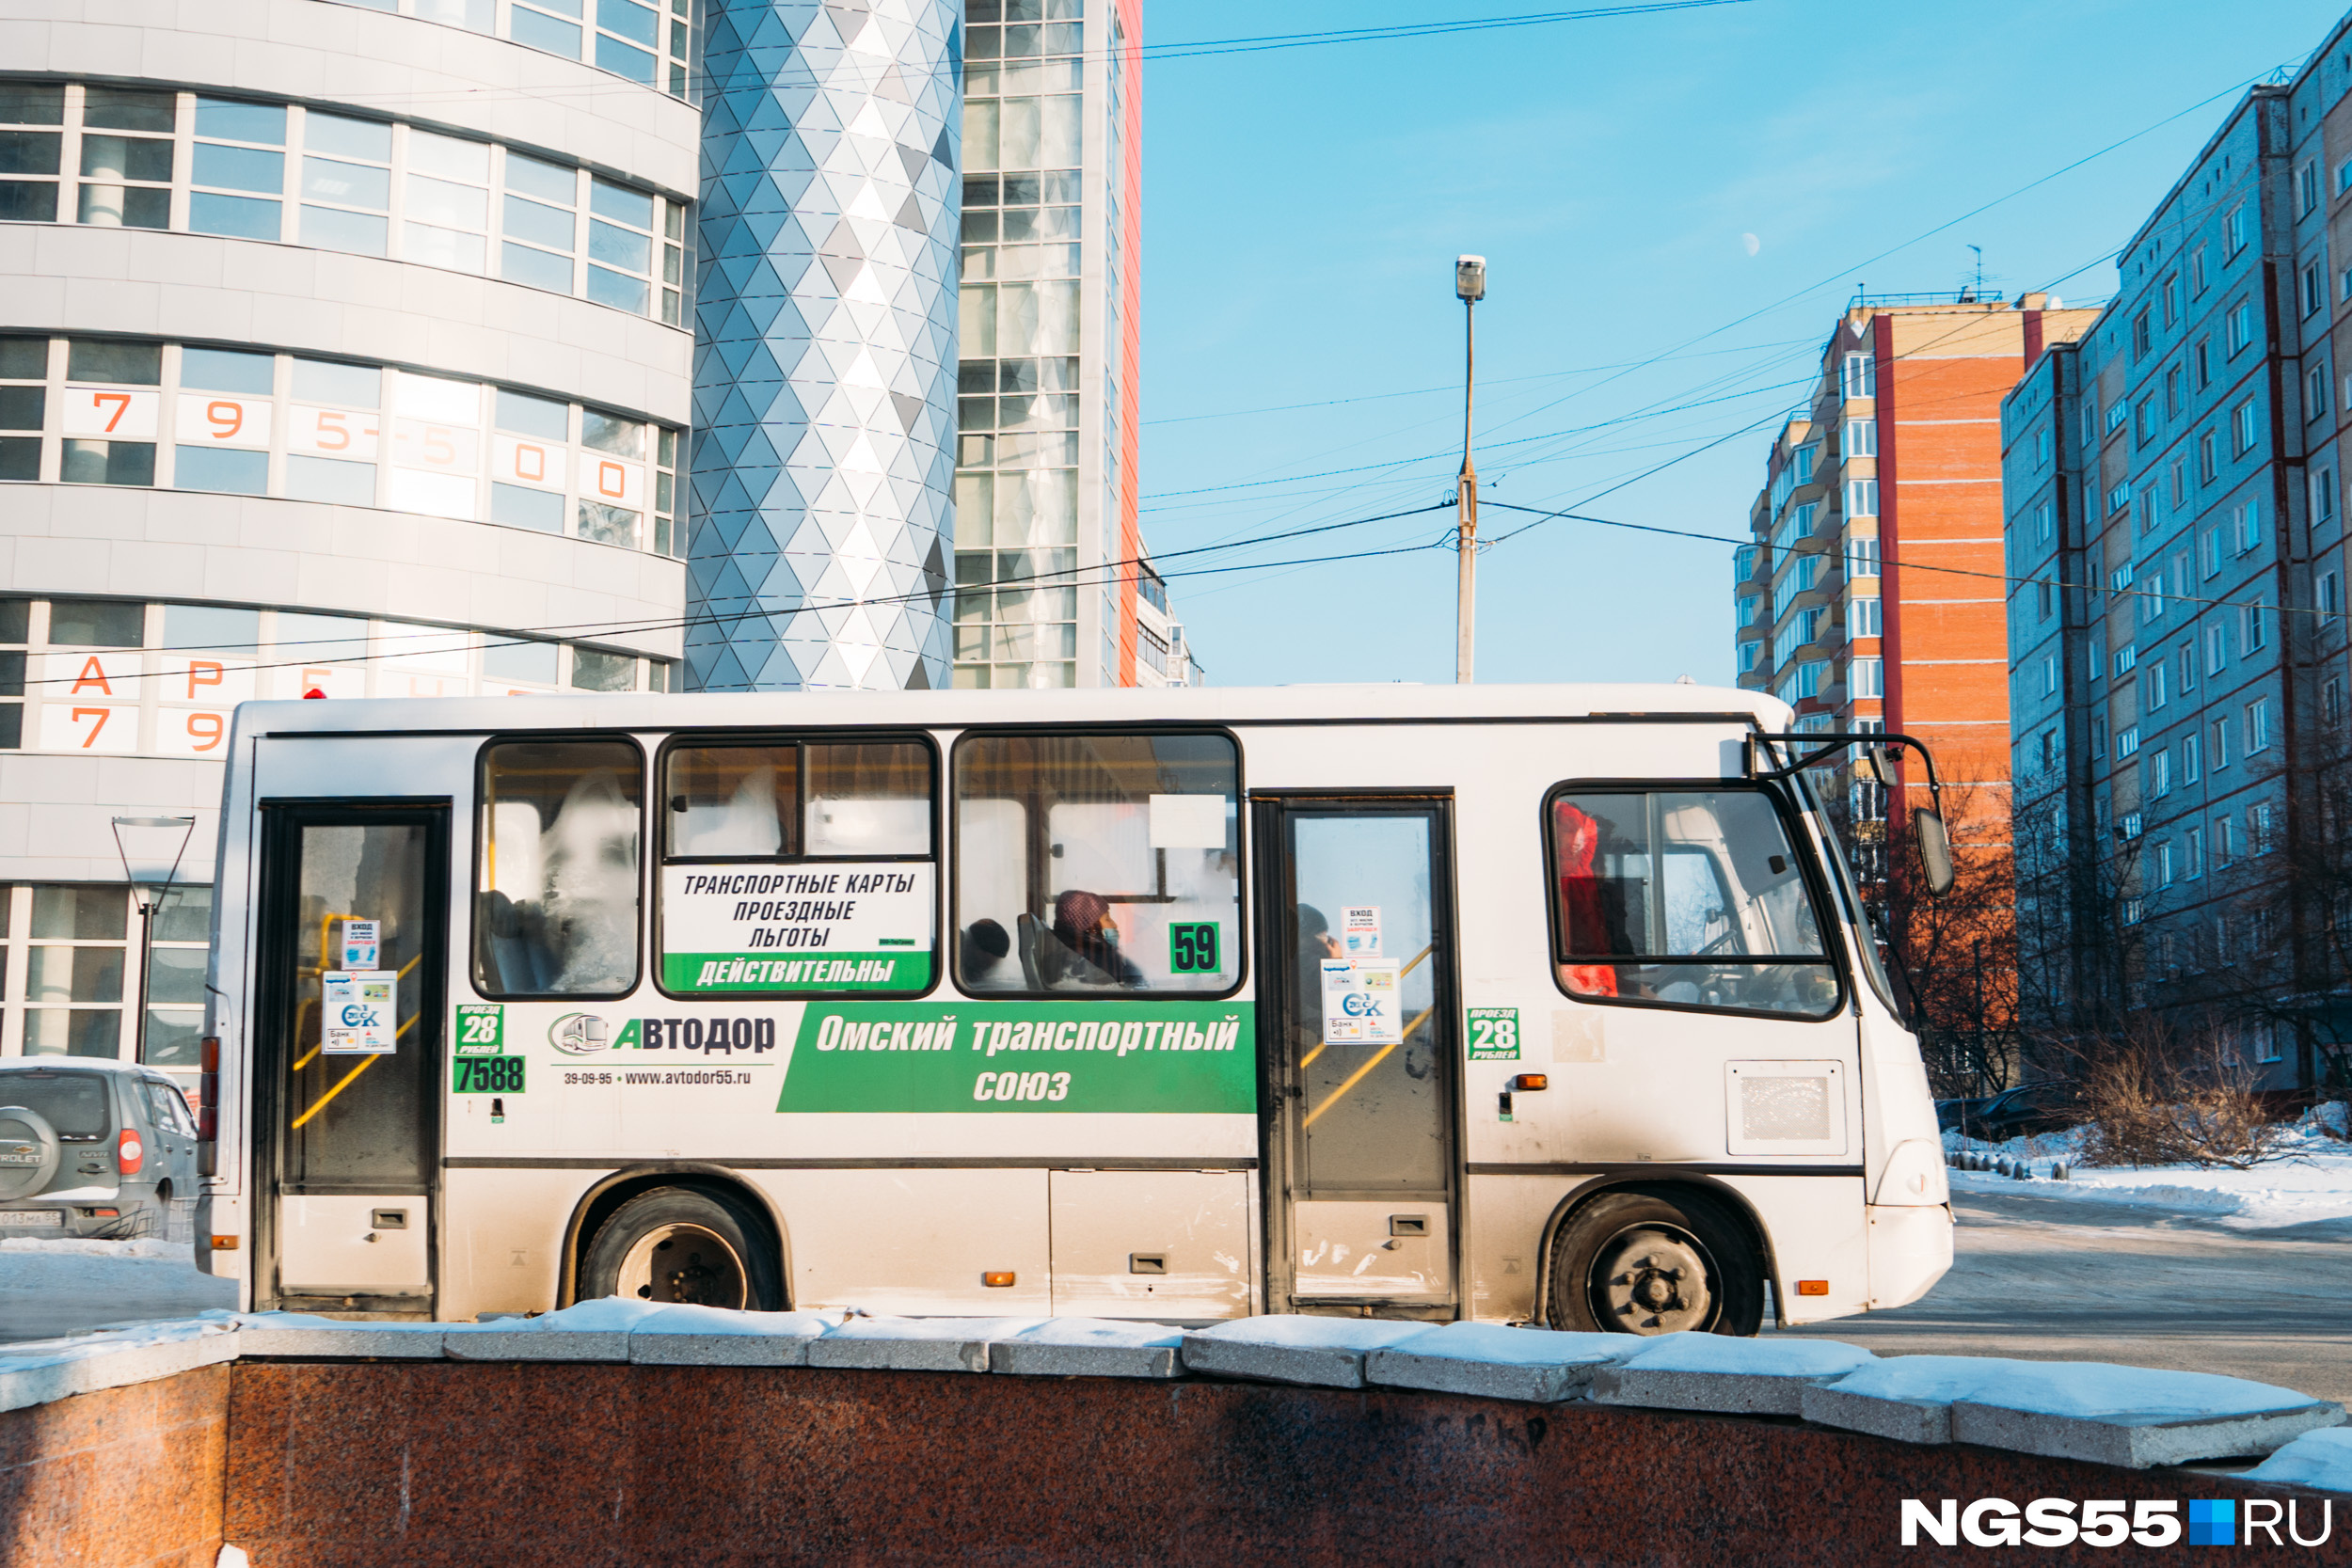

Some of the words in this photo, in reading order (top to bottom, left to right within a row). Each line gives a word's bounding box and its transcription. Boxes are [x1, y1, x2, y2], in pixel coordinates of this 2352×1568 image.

[684, 875, 839, 895] ТРАНСПОРТНЫЕ
[845, 874, 915, 894] КАРТЫ
[733, 901, 856, 923] ПРОЕЗДНЫЕ
[748, 927, 830, 947] ЛЬГОТЫ
[1174, 925, 1216, 971] 59
[696, 957, 896, 987] ДЕЙСТВИТЕЛЬНЫ
[459, 1006, 501, 1015] ПРОЕЗД
[1470, 1008, 1517, 1019] ПРОЕЗД
[461, 1015, 499, 1042] 28
[612, 1018, 775, 1055] Автодор
[816, 1014, 958, 1052] Омский
[971, 1014, 1240, 1057] транспортный
[1472, 1019, 1517, 1049] 28
[459, 1044, 501, 1054] РУБЛЕЙ
[1471, 1050, 1518, 1059] РУБЛЕЙ
[456, 1057, 523, 1091] 7588
[564, 1072, 612, 1085] 39-09-95
[626, 1070, 751, 1085] www.avtodor55.ru
[973, 1070, 1071, 1101] союз
[0, 1154, 41, 1163] ROLET
